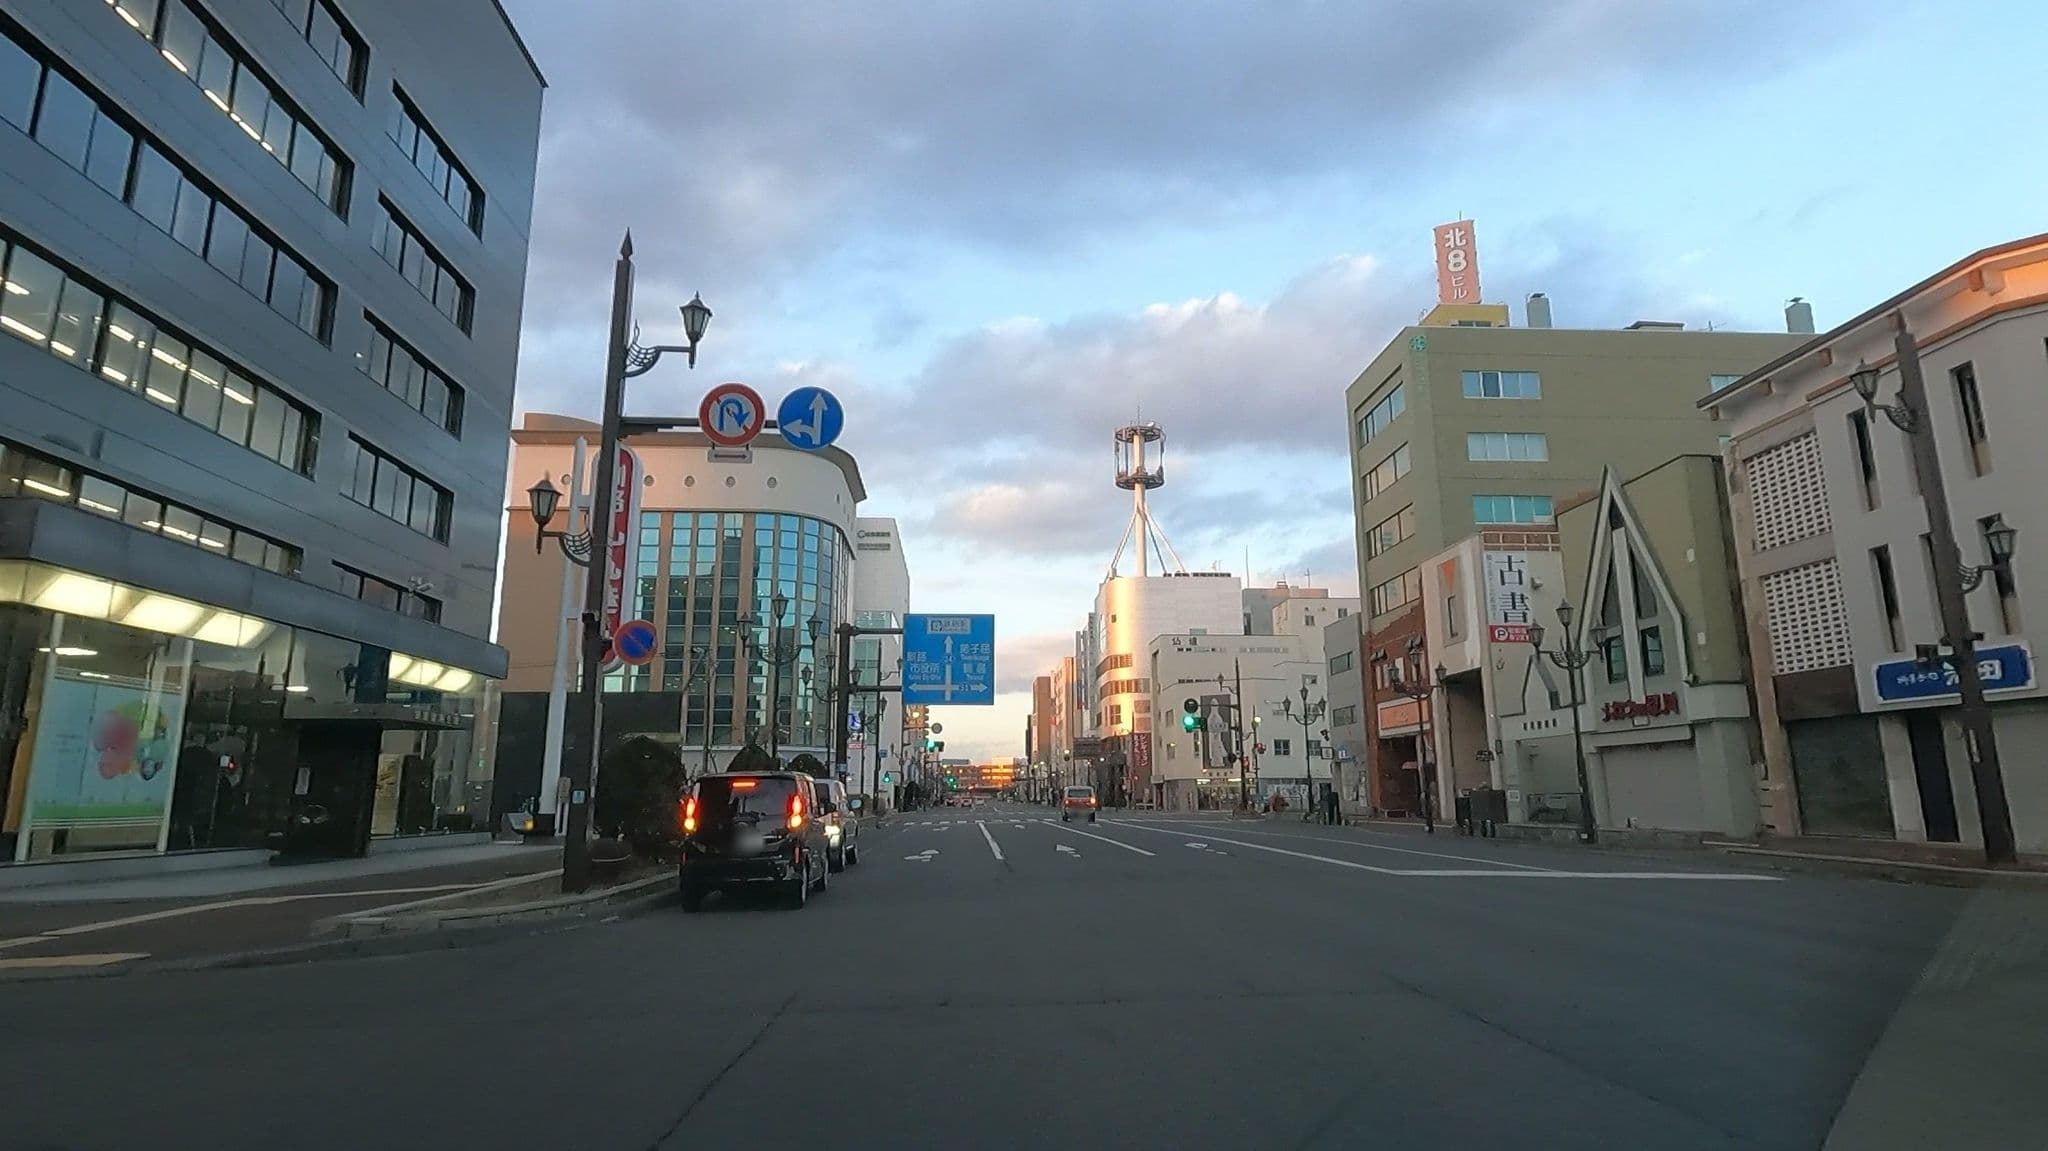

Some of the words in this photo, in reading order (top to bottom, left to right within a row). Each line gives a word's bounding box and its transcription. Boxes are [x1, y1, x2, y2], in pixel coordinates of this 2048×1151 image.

[1444, 228, 1469, 300] 北8ビル
[1495, 554, 1530, 624] 古書
